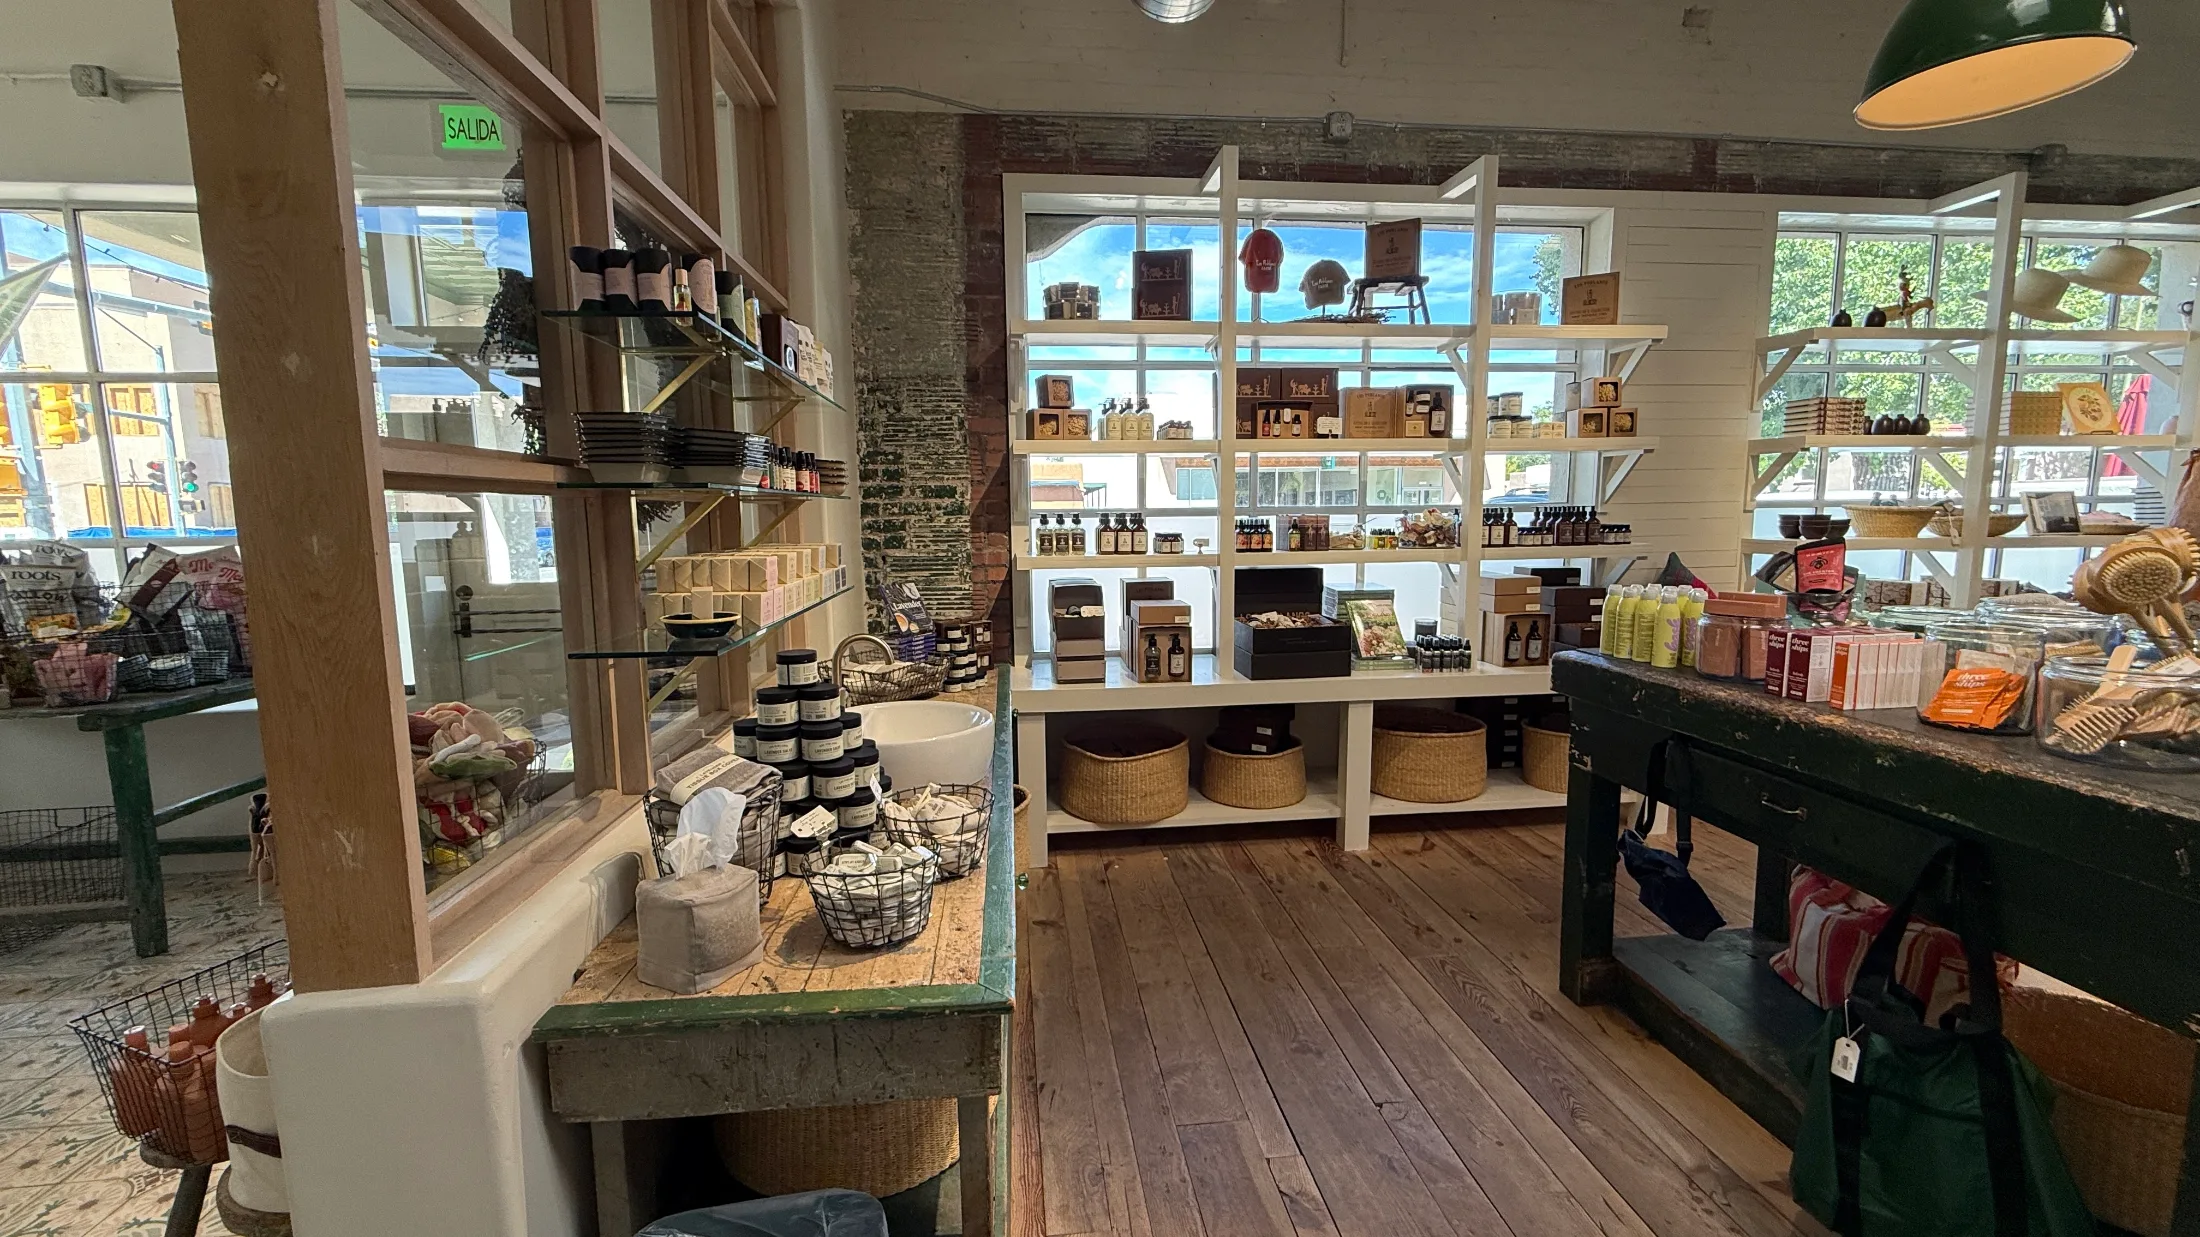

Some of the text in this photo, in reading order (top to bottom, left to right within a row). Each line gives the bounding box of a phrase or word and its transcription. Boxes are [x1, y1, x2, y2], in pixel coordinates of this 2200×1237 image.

[447, 117, 500, 142] SALIDA
[12, 571, 61, 581] roots
[892, 600, 921, 610] Lavender
[1769, 634, 1786, 642] three
[1791, 638, 1810, 646] three
[1768, 641, 1785, 649] ships
[1791, 645, 1809, 653] ships
[1957, 673, 1990, 681] three
[1955, 680, 1987, 688] ships
[686, 774, 709, 789] TISSUE
